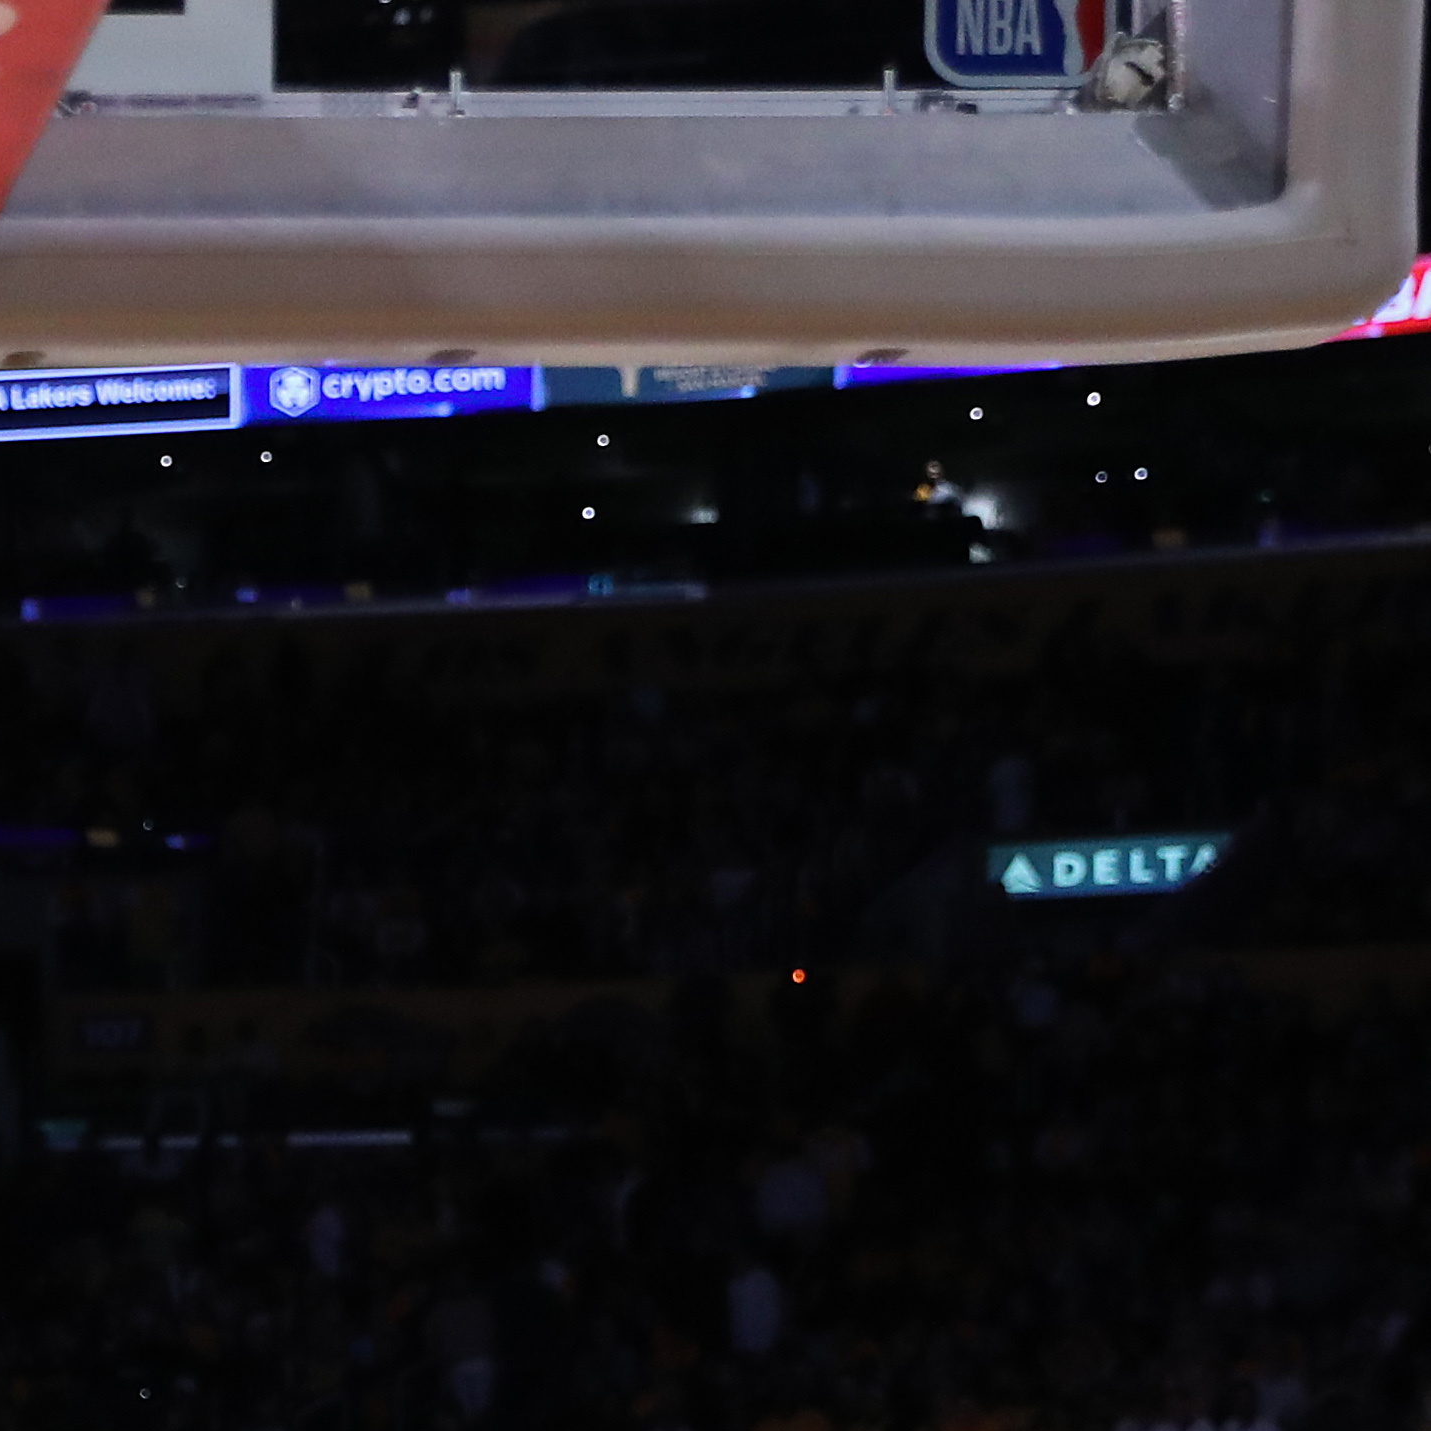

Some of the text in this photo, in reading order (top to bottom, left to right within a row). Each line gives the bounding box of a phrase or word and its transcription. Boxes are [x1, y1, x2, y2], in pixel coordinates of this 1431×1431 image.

[954, 0, 1041, 55] NBA
[10, 382, 95, 411] Lakers
[322, 366, 507, 403] crypto.com
